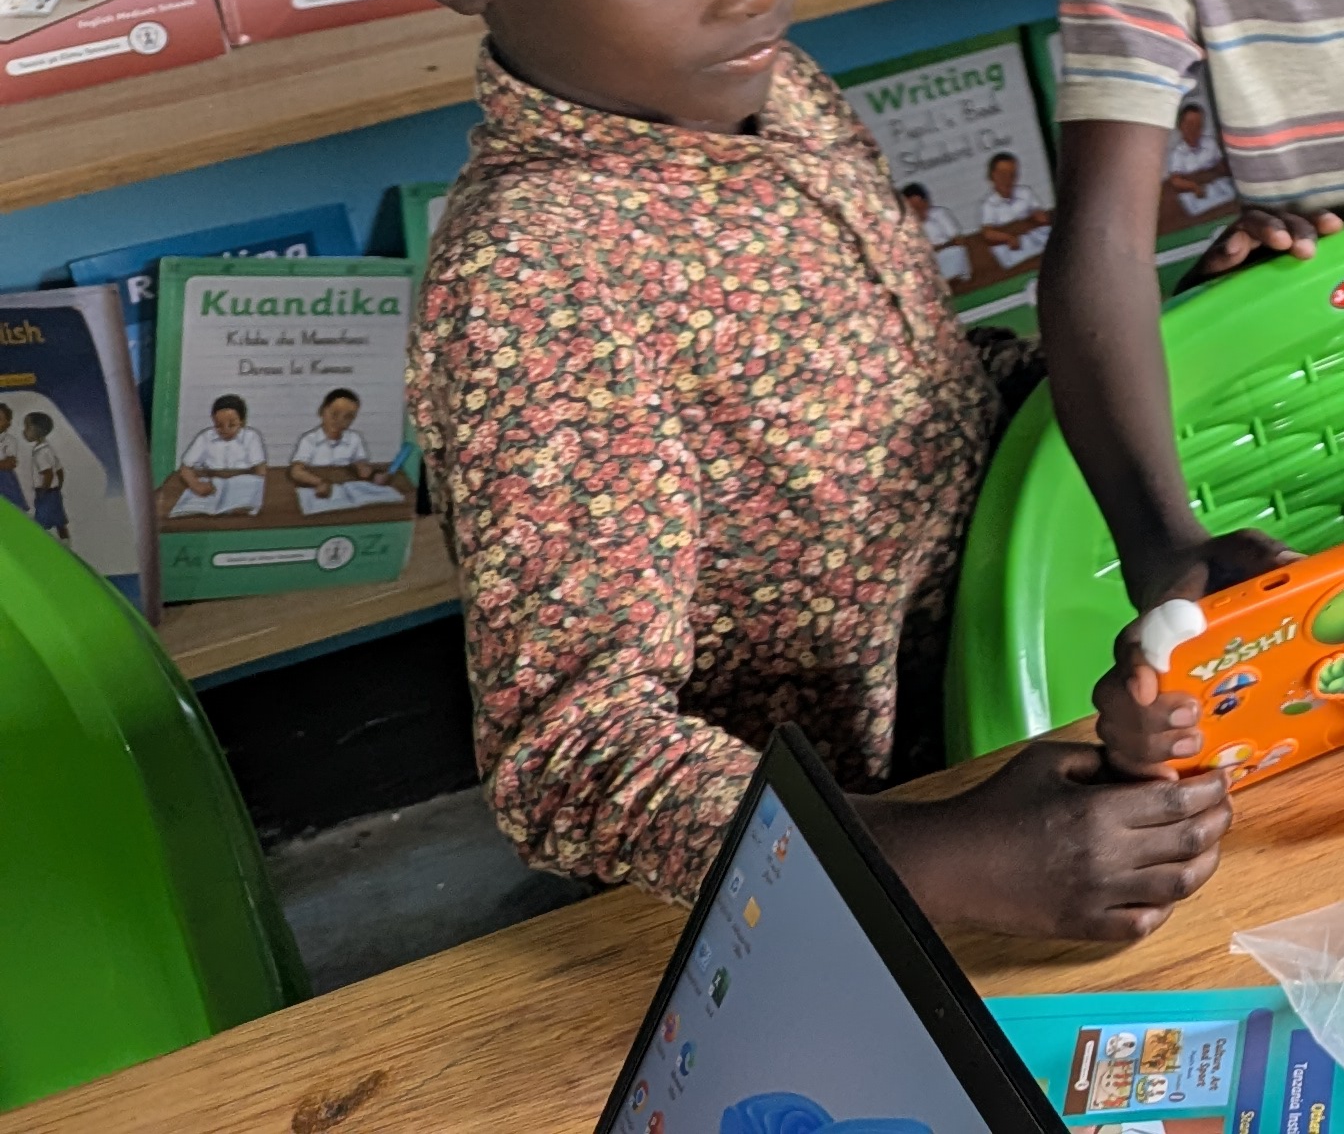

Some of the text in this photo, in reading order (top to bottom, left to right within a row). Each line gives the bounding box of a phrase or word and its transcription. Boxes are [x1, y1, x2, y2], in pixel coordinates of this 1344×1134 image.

[865, 61, 1006, 114] Writing
[200, 287, 403, 316] Kuandika
[1189, 616, 1299, 682] YOSHI
[1288, 1061, 1309, 1111] Tanzania
